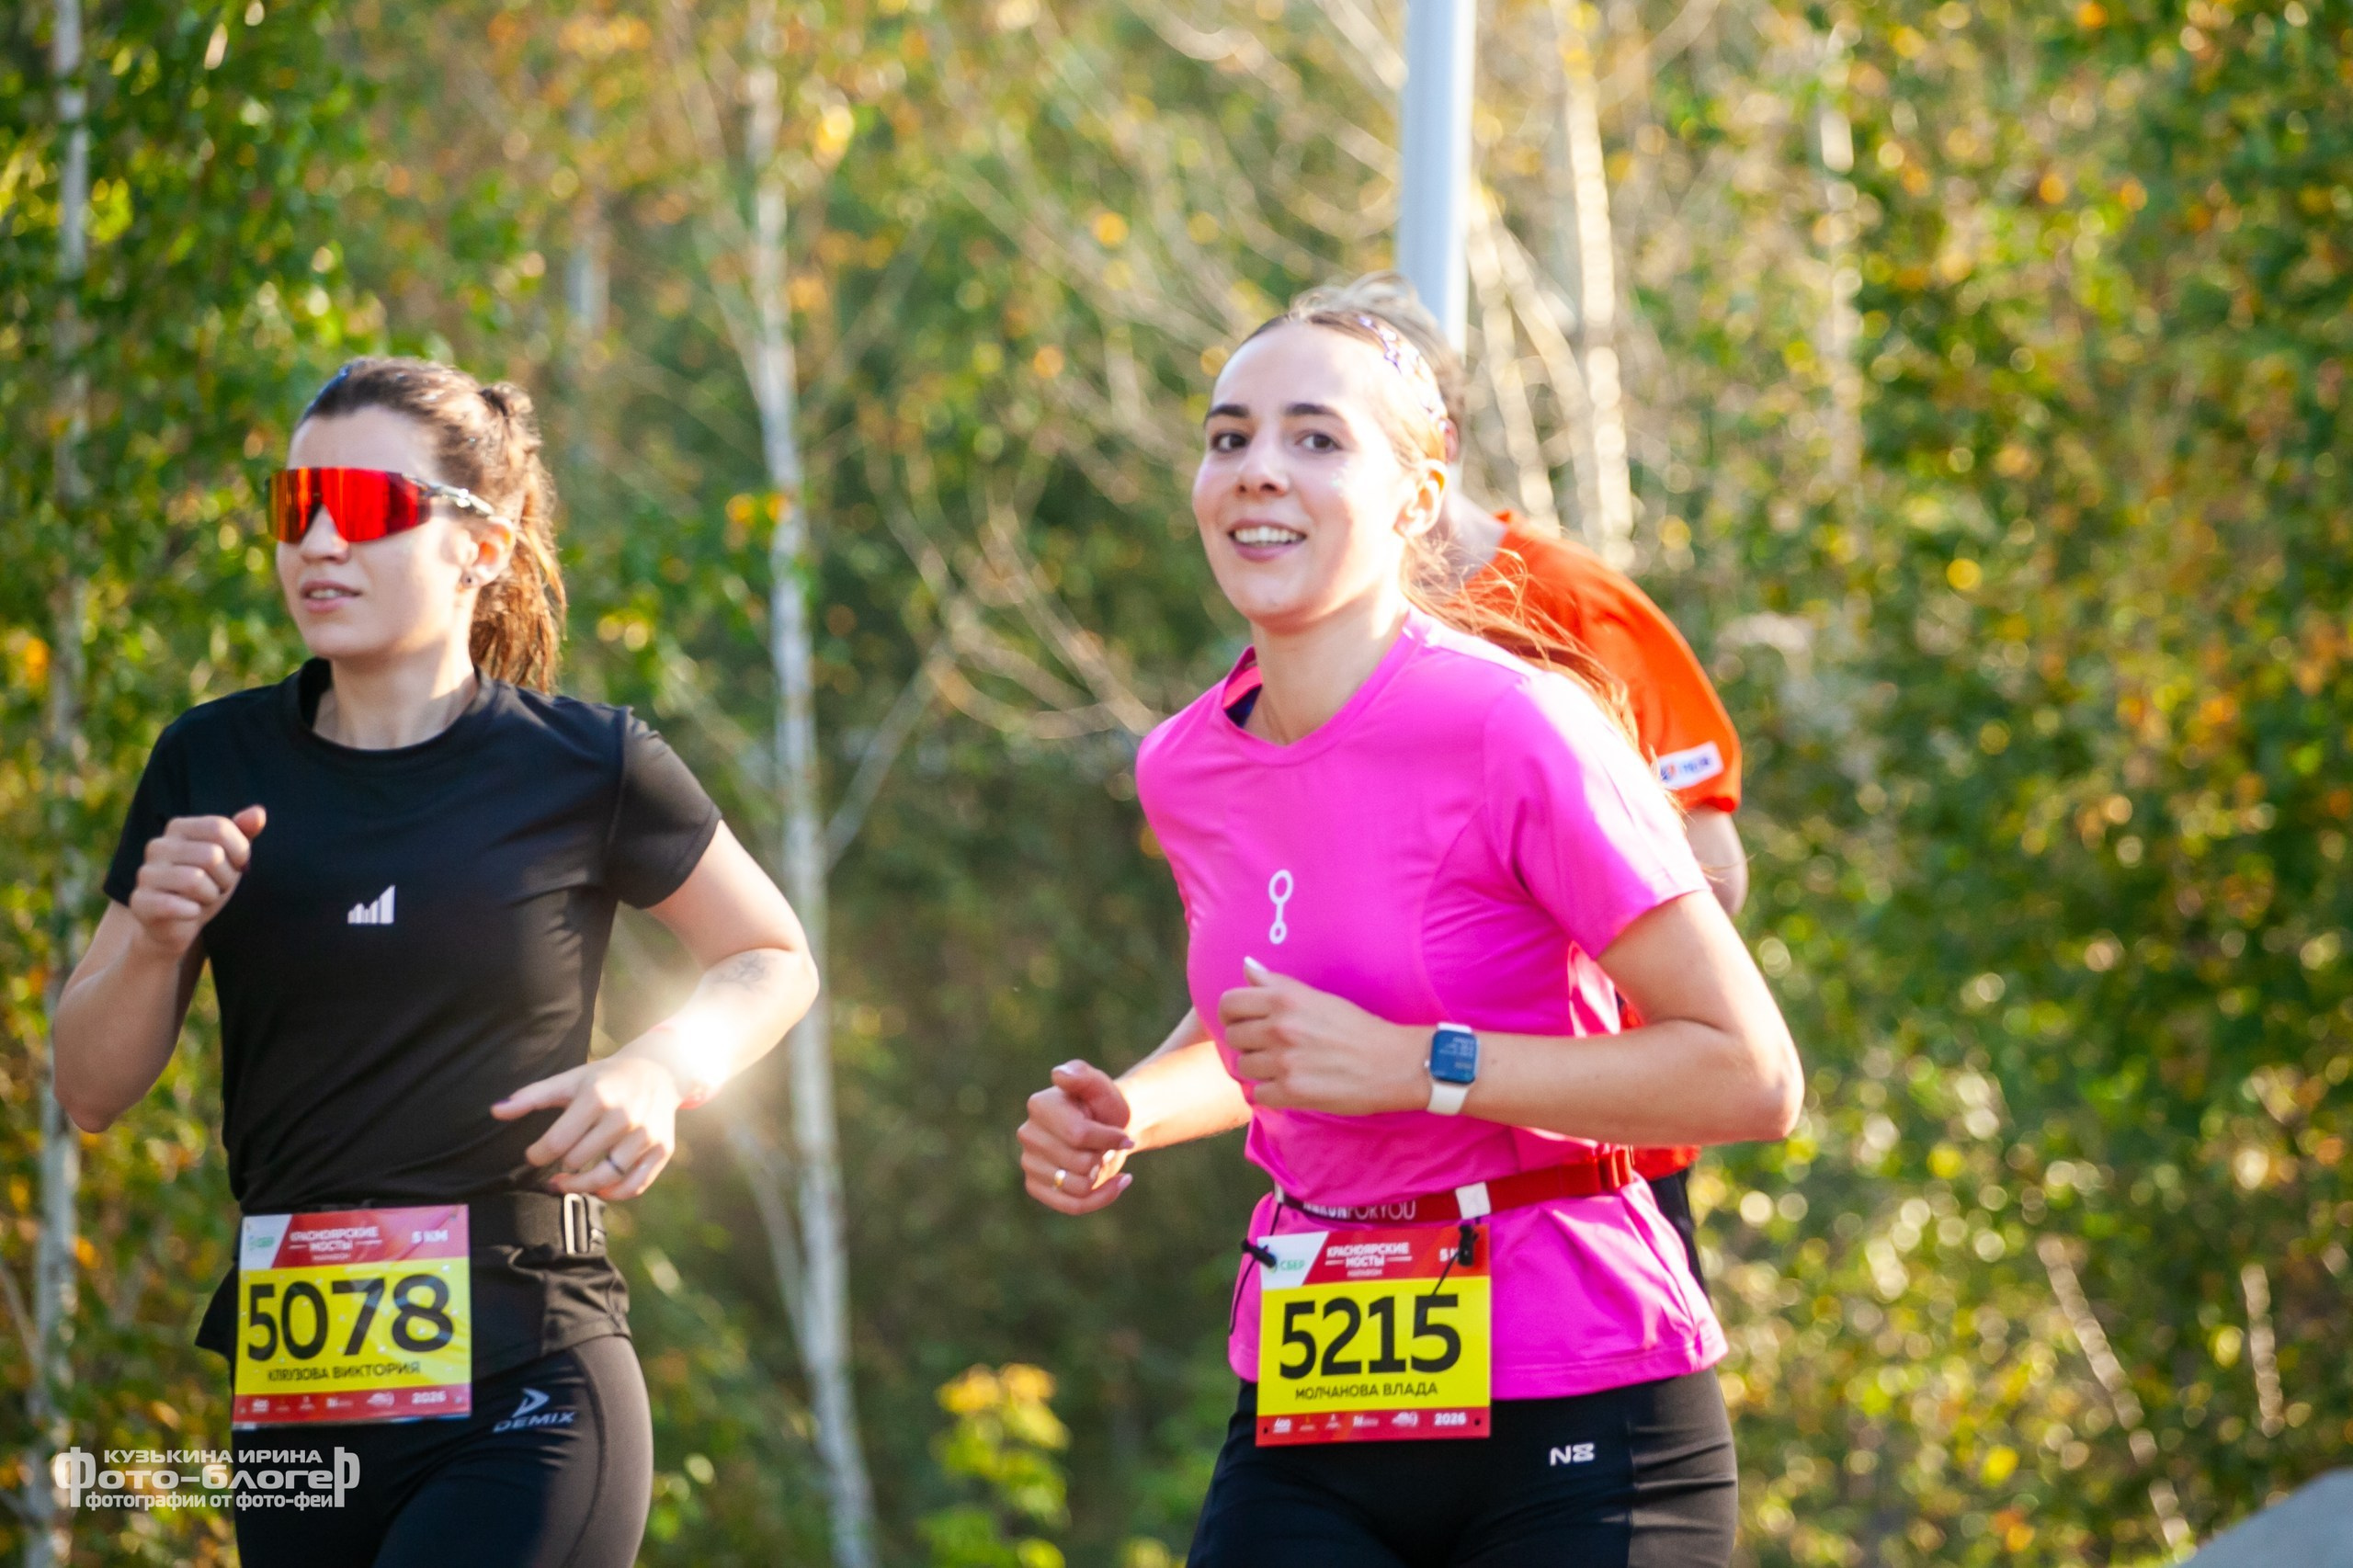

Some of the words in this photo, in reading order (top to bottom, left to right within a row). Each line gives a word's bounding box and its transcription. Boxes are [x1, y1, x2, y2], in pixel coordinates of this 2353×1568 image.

[1326, 1242, 1410, 1257] КРАСНОЯРСКИЕ
[1280, 1259, 1305, 1271] СБЕР
[1345, 1255, 1385, 1267] МОСТЫ
[247, 1273, 454, 1362] 5078
[1279, 1294, 1462, 1381] 5215
[333, 1361, 421, 1379] ВИКТОРИЯ
[1295, 1384, 1379, 1400] МОЛЧАНОВА
[1383, 1381, 1438, 1397] ВЛАДА
[493, 1411, 575, 1433] DEMIX
[1434, 1412, 1467, 1426] 2026
